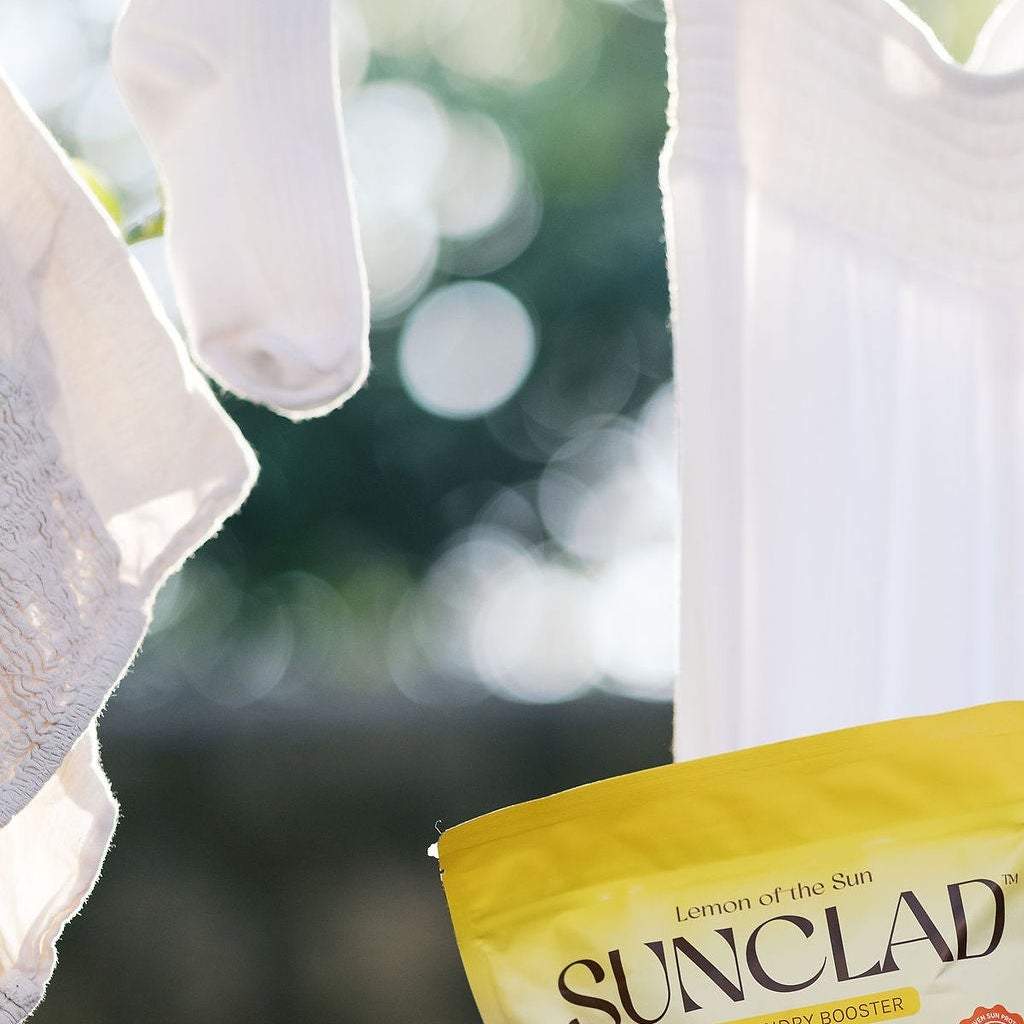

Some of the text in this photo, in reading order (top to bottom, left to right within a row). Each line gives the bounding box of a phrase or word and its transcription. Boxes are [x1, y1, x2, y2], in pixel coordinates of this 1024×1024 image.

[675, 867, 874, 923] Lemon of the Sun
[986, 1012, 1000, 1020] SUN
